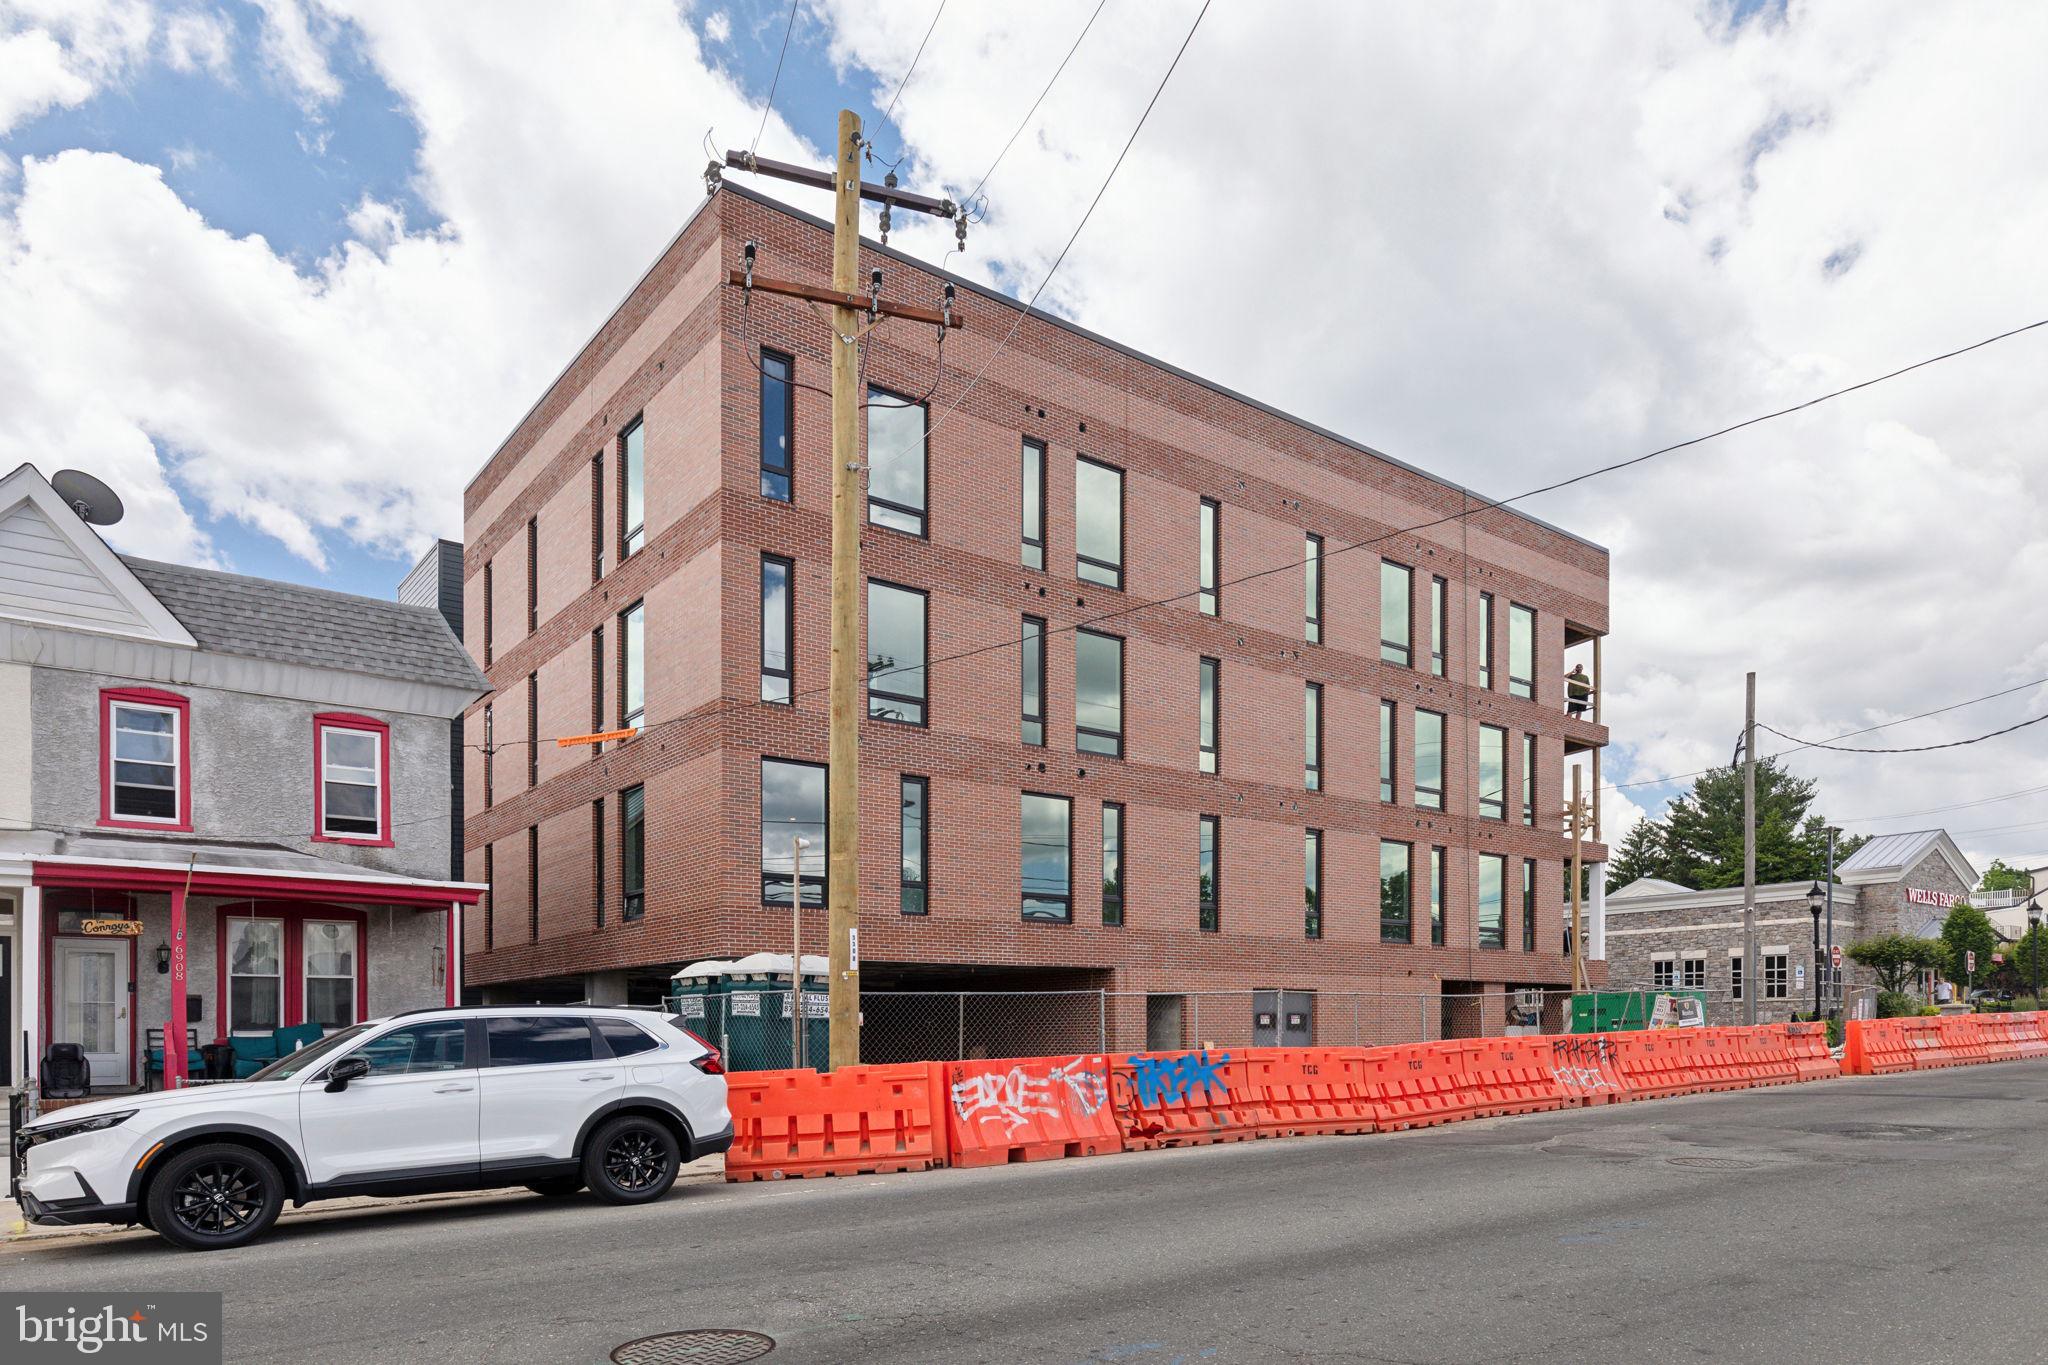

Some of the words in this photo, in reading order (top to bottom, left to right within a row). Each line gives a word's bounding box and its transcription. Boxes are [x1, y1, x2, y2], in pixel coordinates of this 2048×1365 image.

[1907, 887, 1938, 906] WELLS
[1938, 892, 1967, 908] FARGO
[175, 944, 184, 981] 6908
[1302, 1064, 1319, 1075] TCG
[1408, 1060, 1423, 1070] TCG
